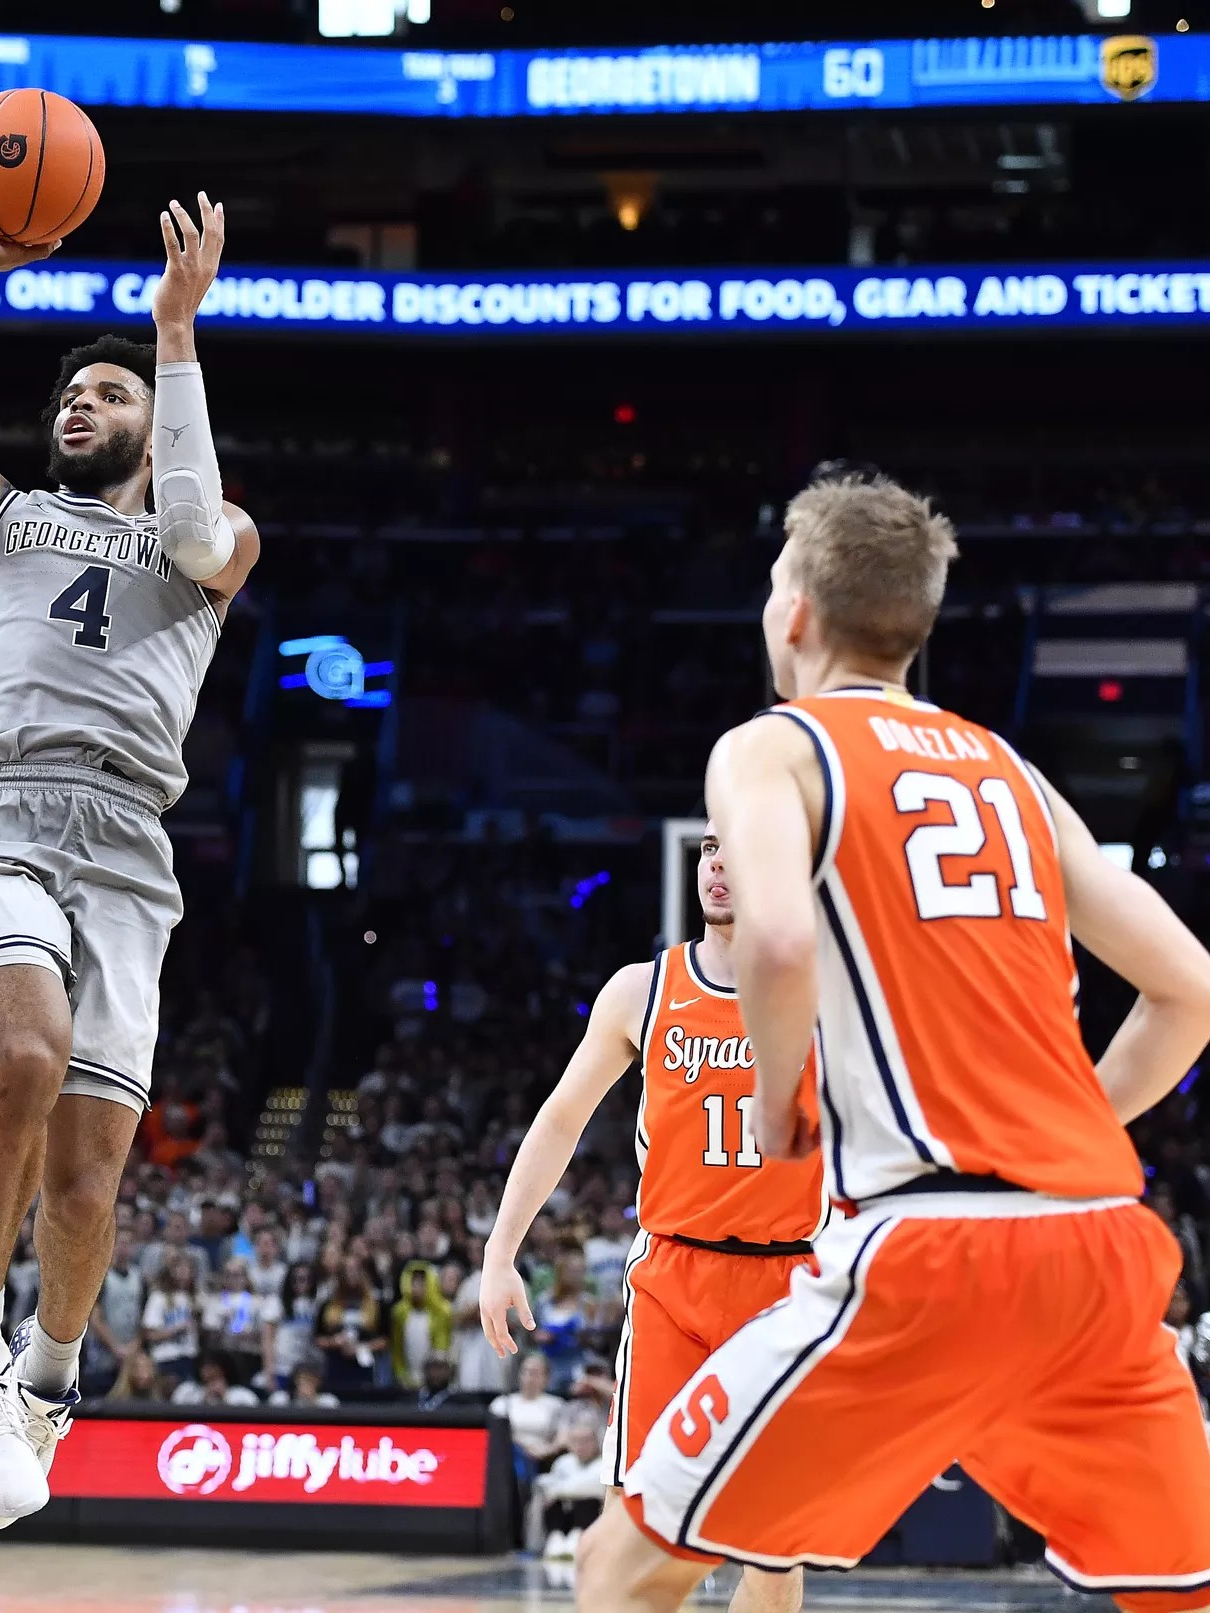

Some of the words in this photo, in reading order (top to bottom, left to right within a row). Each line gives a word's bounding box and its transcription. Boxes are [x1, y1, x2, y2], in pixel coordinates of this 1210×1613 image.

[112, 272, 386, 322] CADHOLDER
[392, 281, 620, 324] DISCOUNTS
[627, 280, 712, 322] FOR
[719, 278, 847, 327] FOOD,
[853, 277, 968, 319] GEAR
[974, 275, 1068, 317] AND
[3, 520, 174, 584] GEORGETOWN
[47, 564, 113, 652] 4
[892, 770, 1048, 922] 21
[663, 1025, 757, 1084] Syrac
[702, 1094, 763, 1168] 11
[669, 1374, 729, 1457] S
